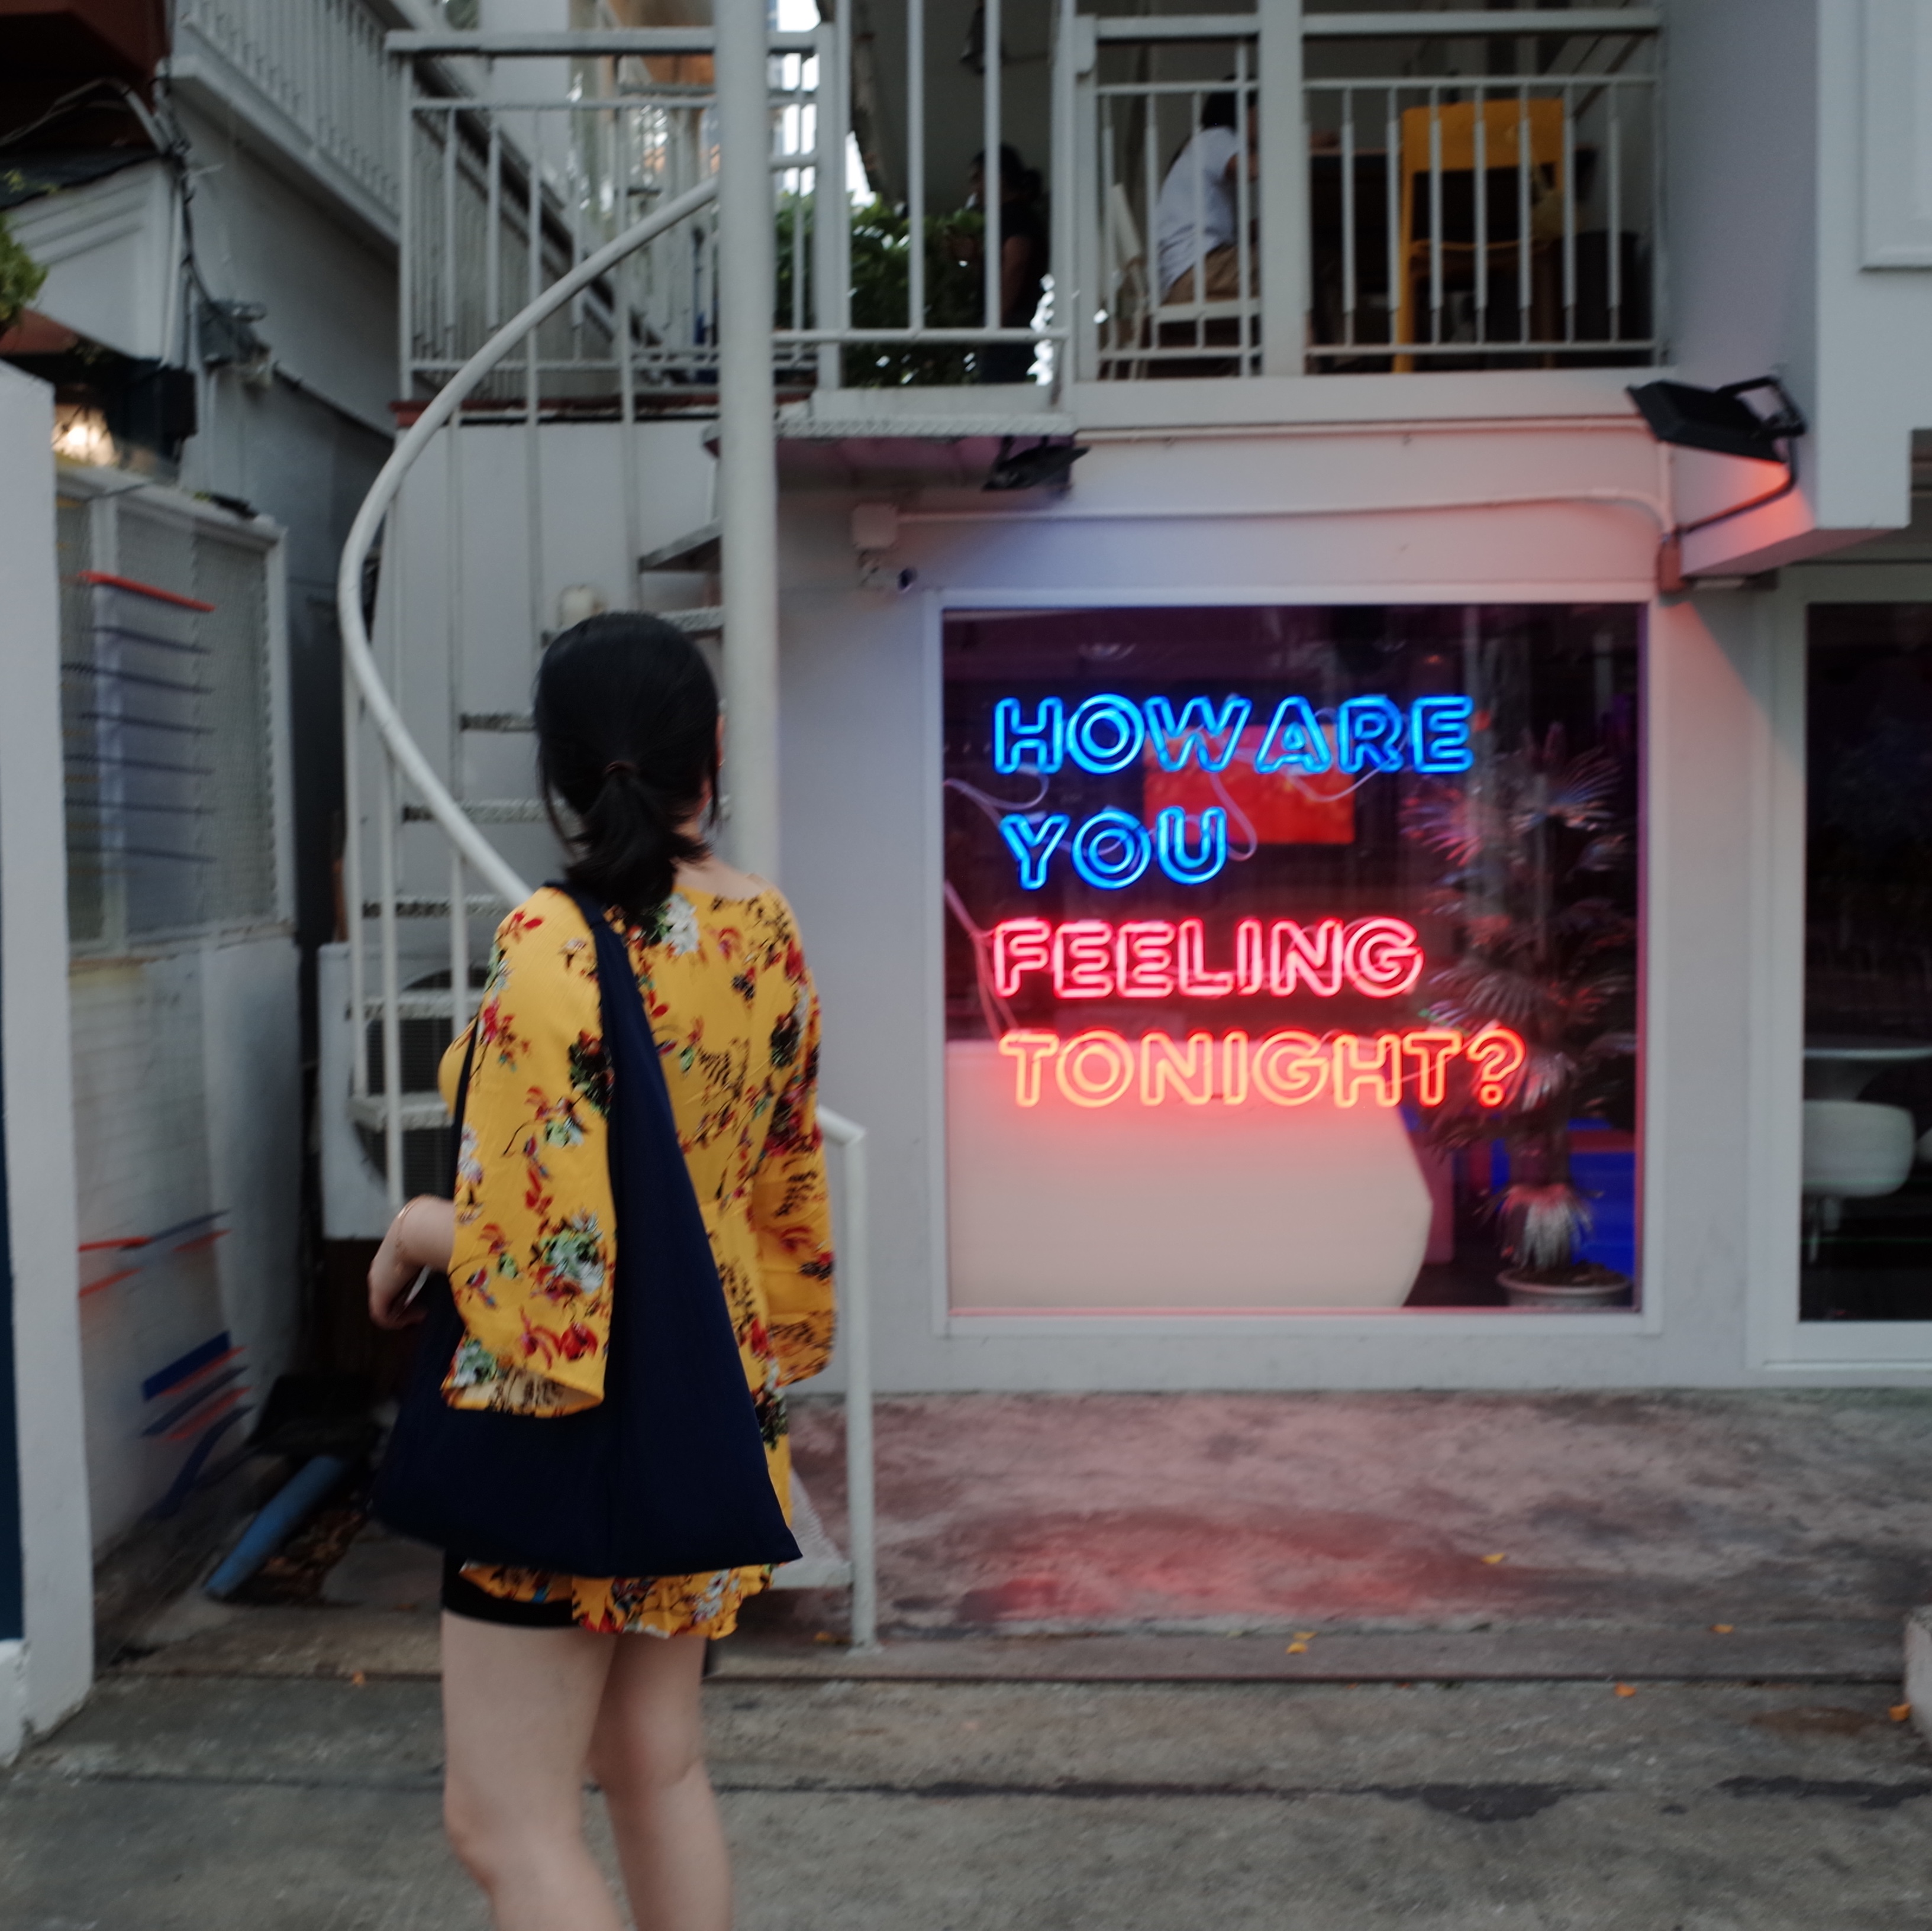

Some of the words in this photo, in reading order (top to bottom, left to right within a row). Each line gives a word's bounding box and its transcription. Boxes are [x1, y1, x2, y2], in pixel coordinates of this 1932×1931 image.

[994, 693, 1250, 774] HOW
[1255, 695, 1474, 774] ARE
[1001, 806, 1228, 890] YOU
[993, 918, 1424, 999] FEELING
[998, 1027, 1526, 1107] TONIGHT?
